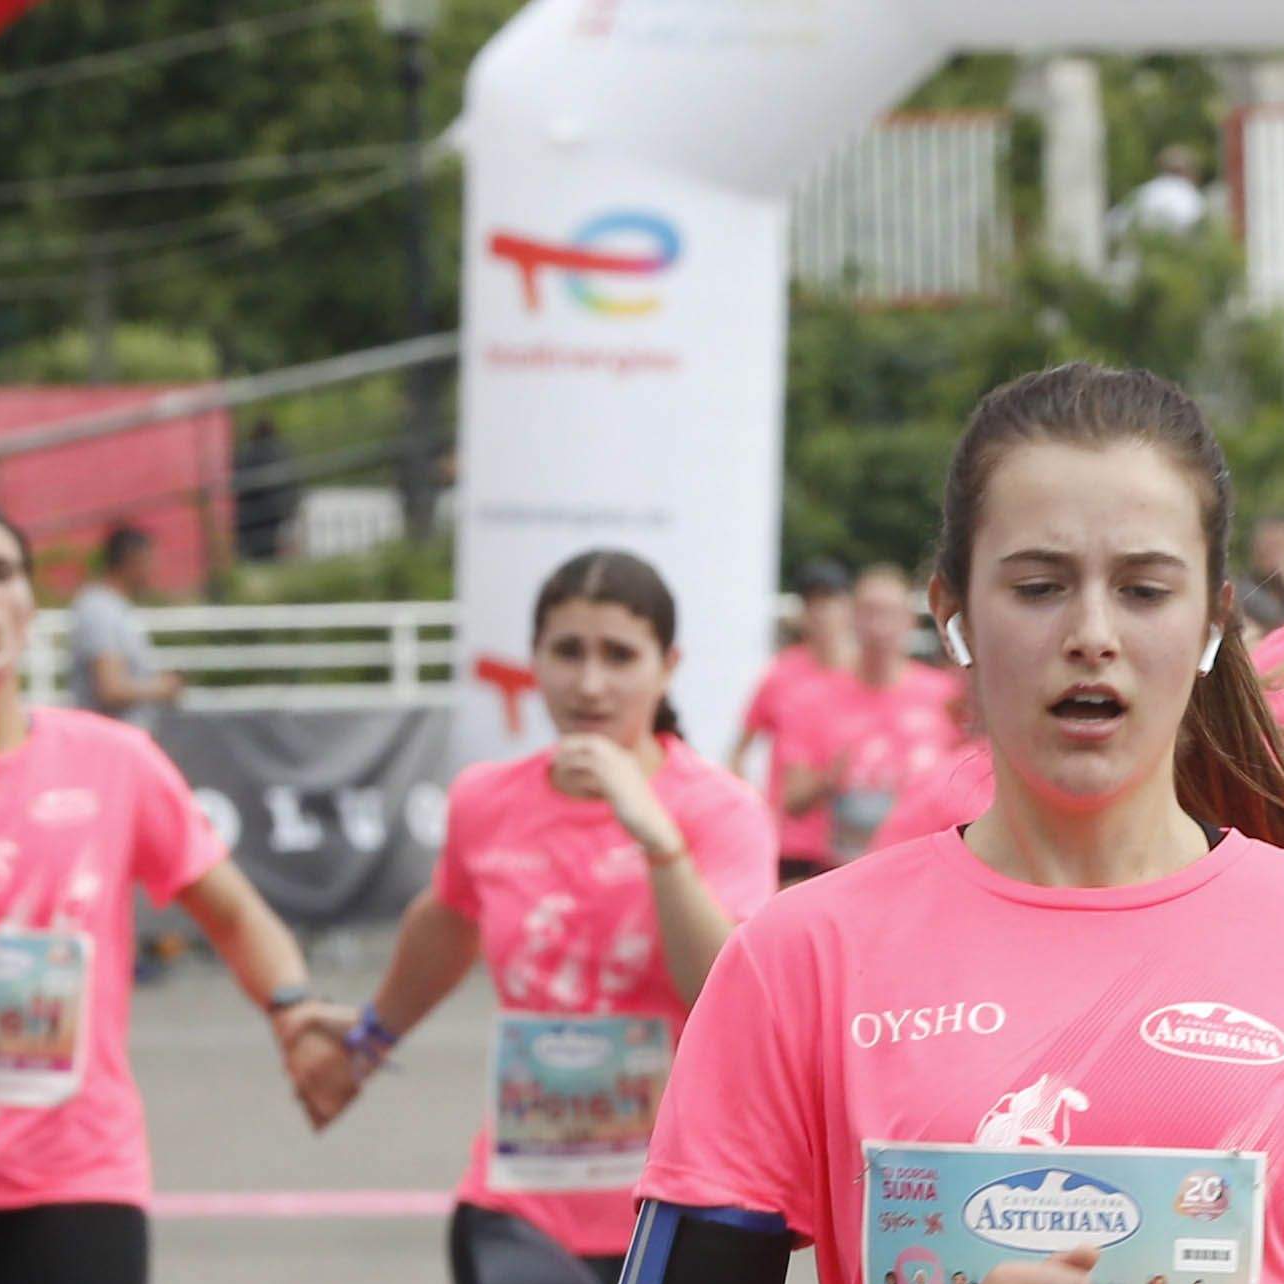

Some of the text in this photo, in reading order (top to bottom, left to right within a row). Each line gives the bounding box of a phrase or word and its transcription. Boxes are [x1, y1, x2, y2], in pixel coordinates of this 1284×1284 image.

[850, 1001, 1006, 1049] OYSHO
[1154, 1015, 1280, 1058] ASTURIANA
[883, 1180, 937, 1200] SUMA
[974, 1197, 1128, 1233] ASTURIANA
